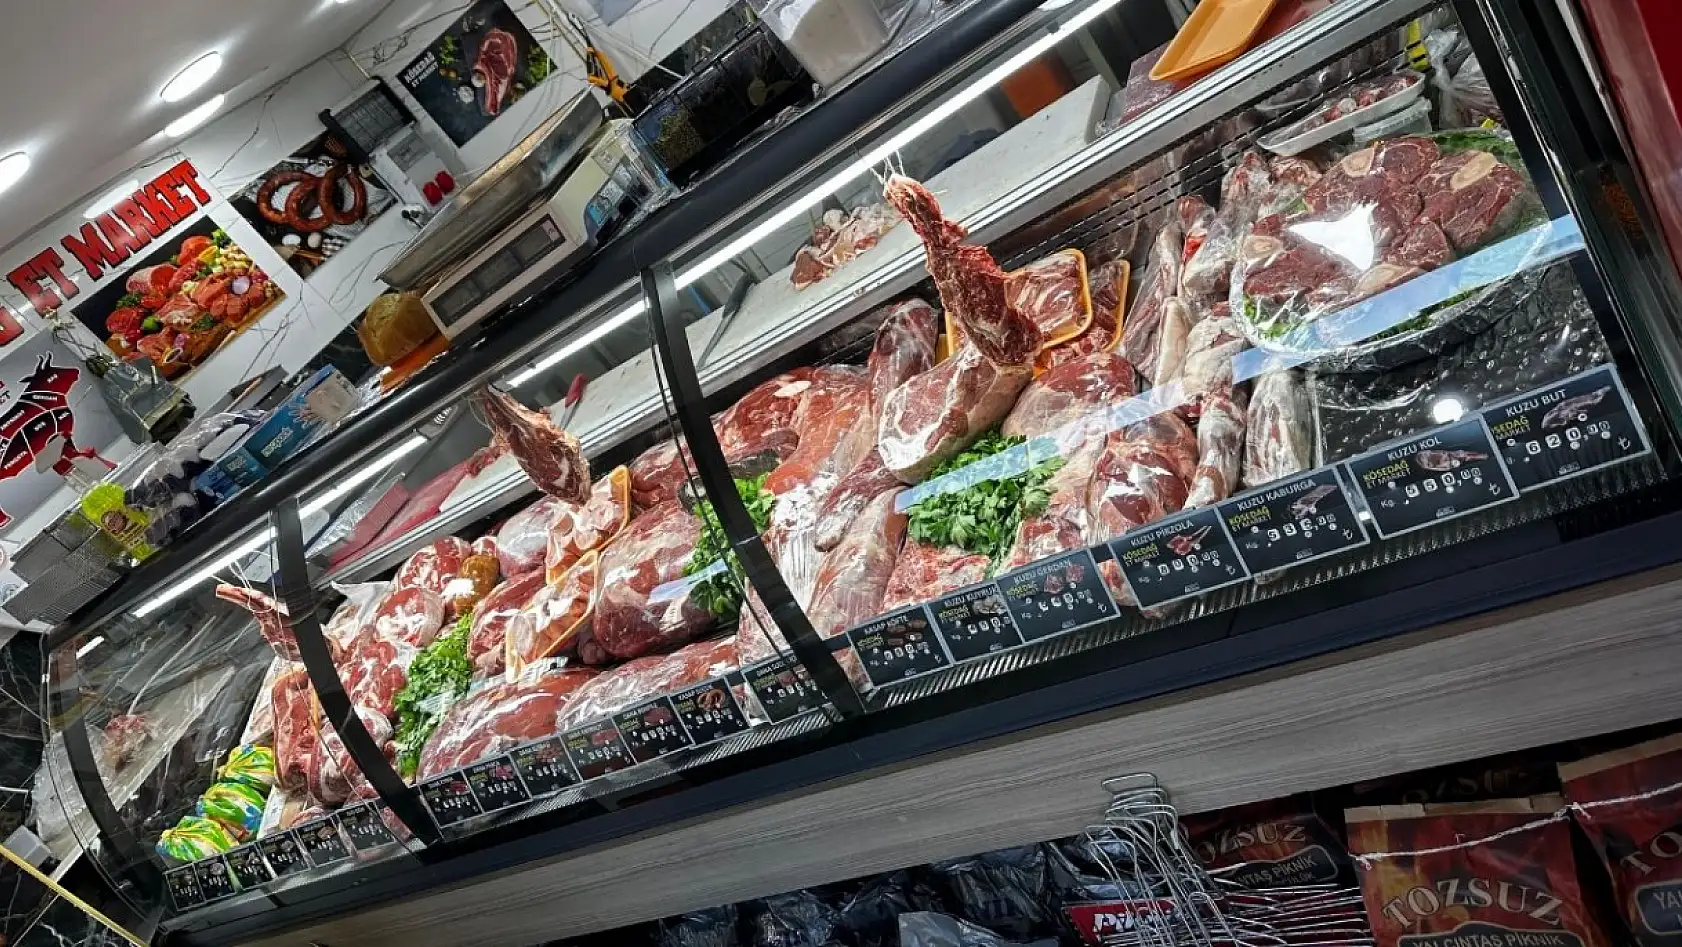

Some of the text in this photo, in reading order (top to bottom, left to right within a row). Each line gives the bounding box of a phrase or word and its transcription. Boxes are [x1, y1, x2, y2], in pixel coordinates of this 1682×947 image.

[6, 159, 212, 319] ET MARKET
[1505, 388, 1567, 418] KUZU BUT
[1491, 415, 1530, 434] SEDAĞ
[1387, 436, 1443, 462] KUZU KOL
[1237, 479, 1317, 512] KUZU KABURGA
[1130, 530, 1156, 546] KUZU
[1196, 821, 1307, 864] OZSUZ
[1382, 876, 1563, 930] TOZSUZ
